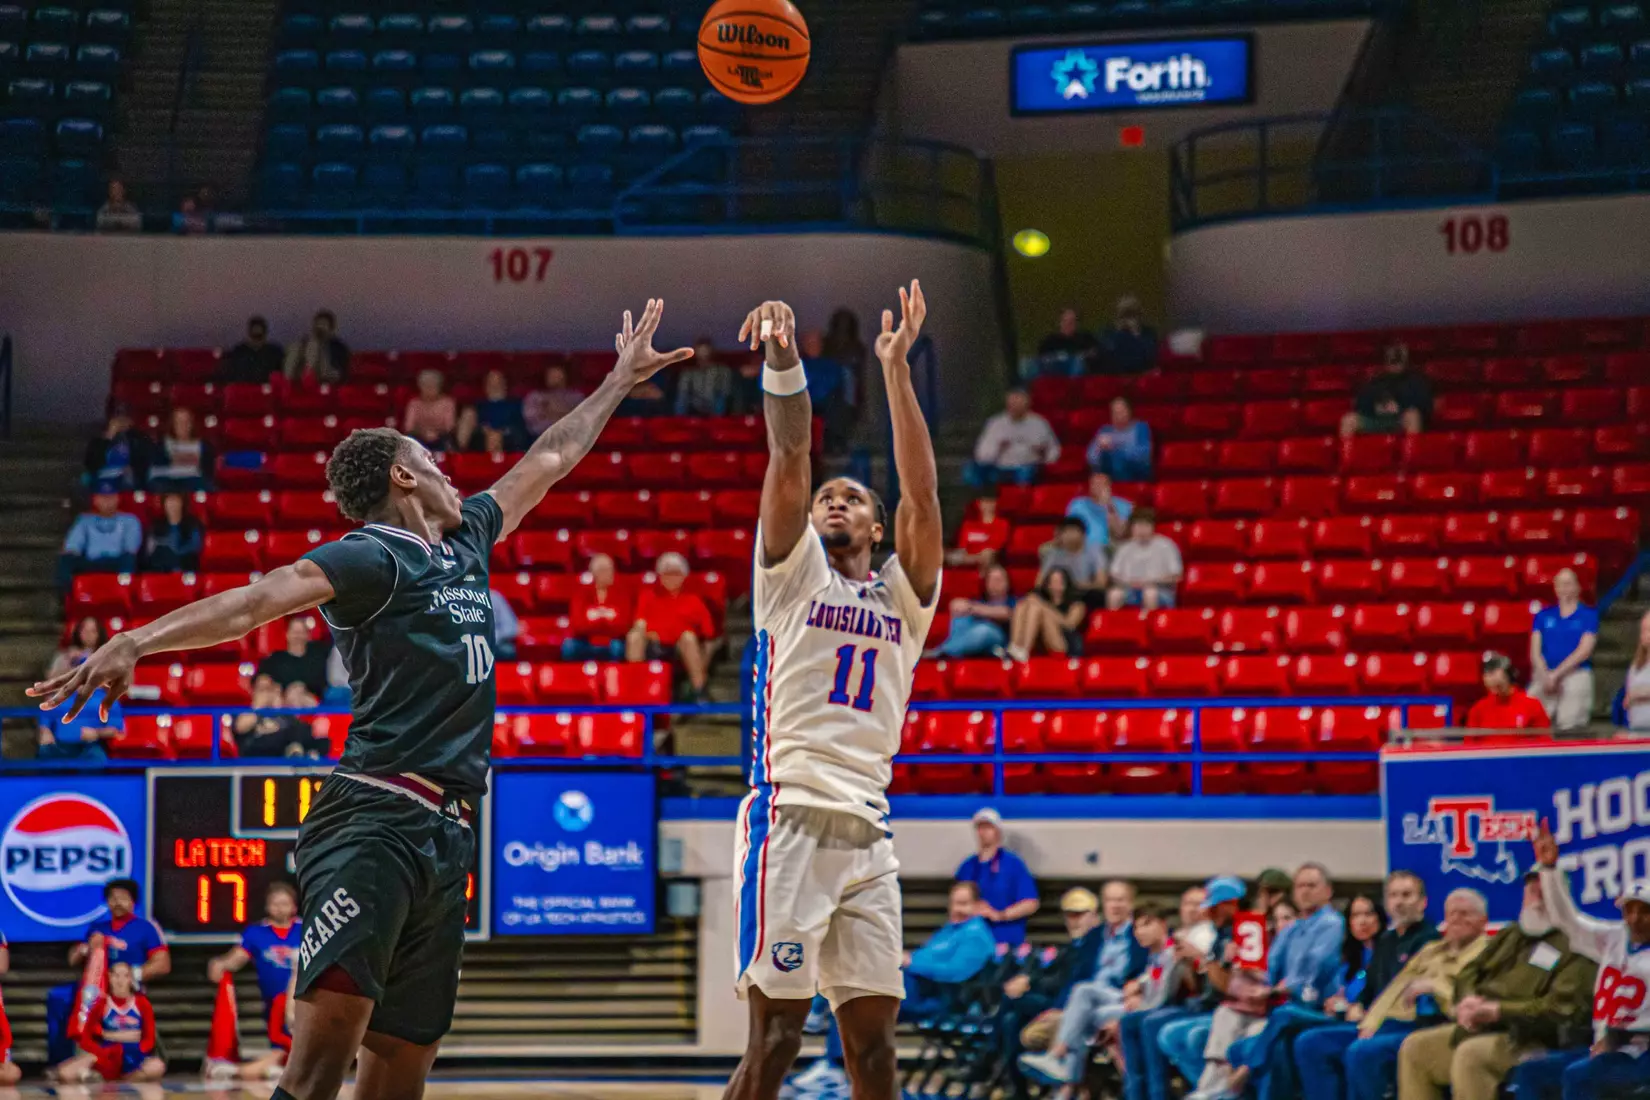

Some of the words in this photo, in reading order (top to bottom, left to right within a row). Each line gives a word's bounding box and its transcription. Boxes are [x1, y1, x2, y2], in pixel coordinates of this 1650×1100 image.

[718, 23, 790, 50] Wilson
[1440, 216, 1509, 254] 108
[489, 246, 553, 283] 107
[448, 602, 486, 624] State
[460, 633, 495, 684] 10
[828, 643, 879, 713] 11
[6, 845, 125, 875] PEPSI
[503, 840, 580, 873] Origin
[584, 840, 645, 866] Bank
[197, 871, 247, 924] 17
[300, 887, 361, 972] BEARS
[1238, 920, 1264, 962] 3
[1592, 966, 1647, 1029] 82
